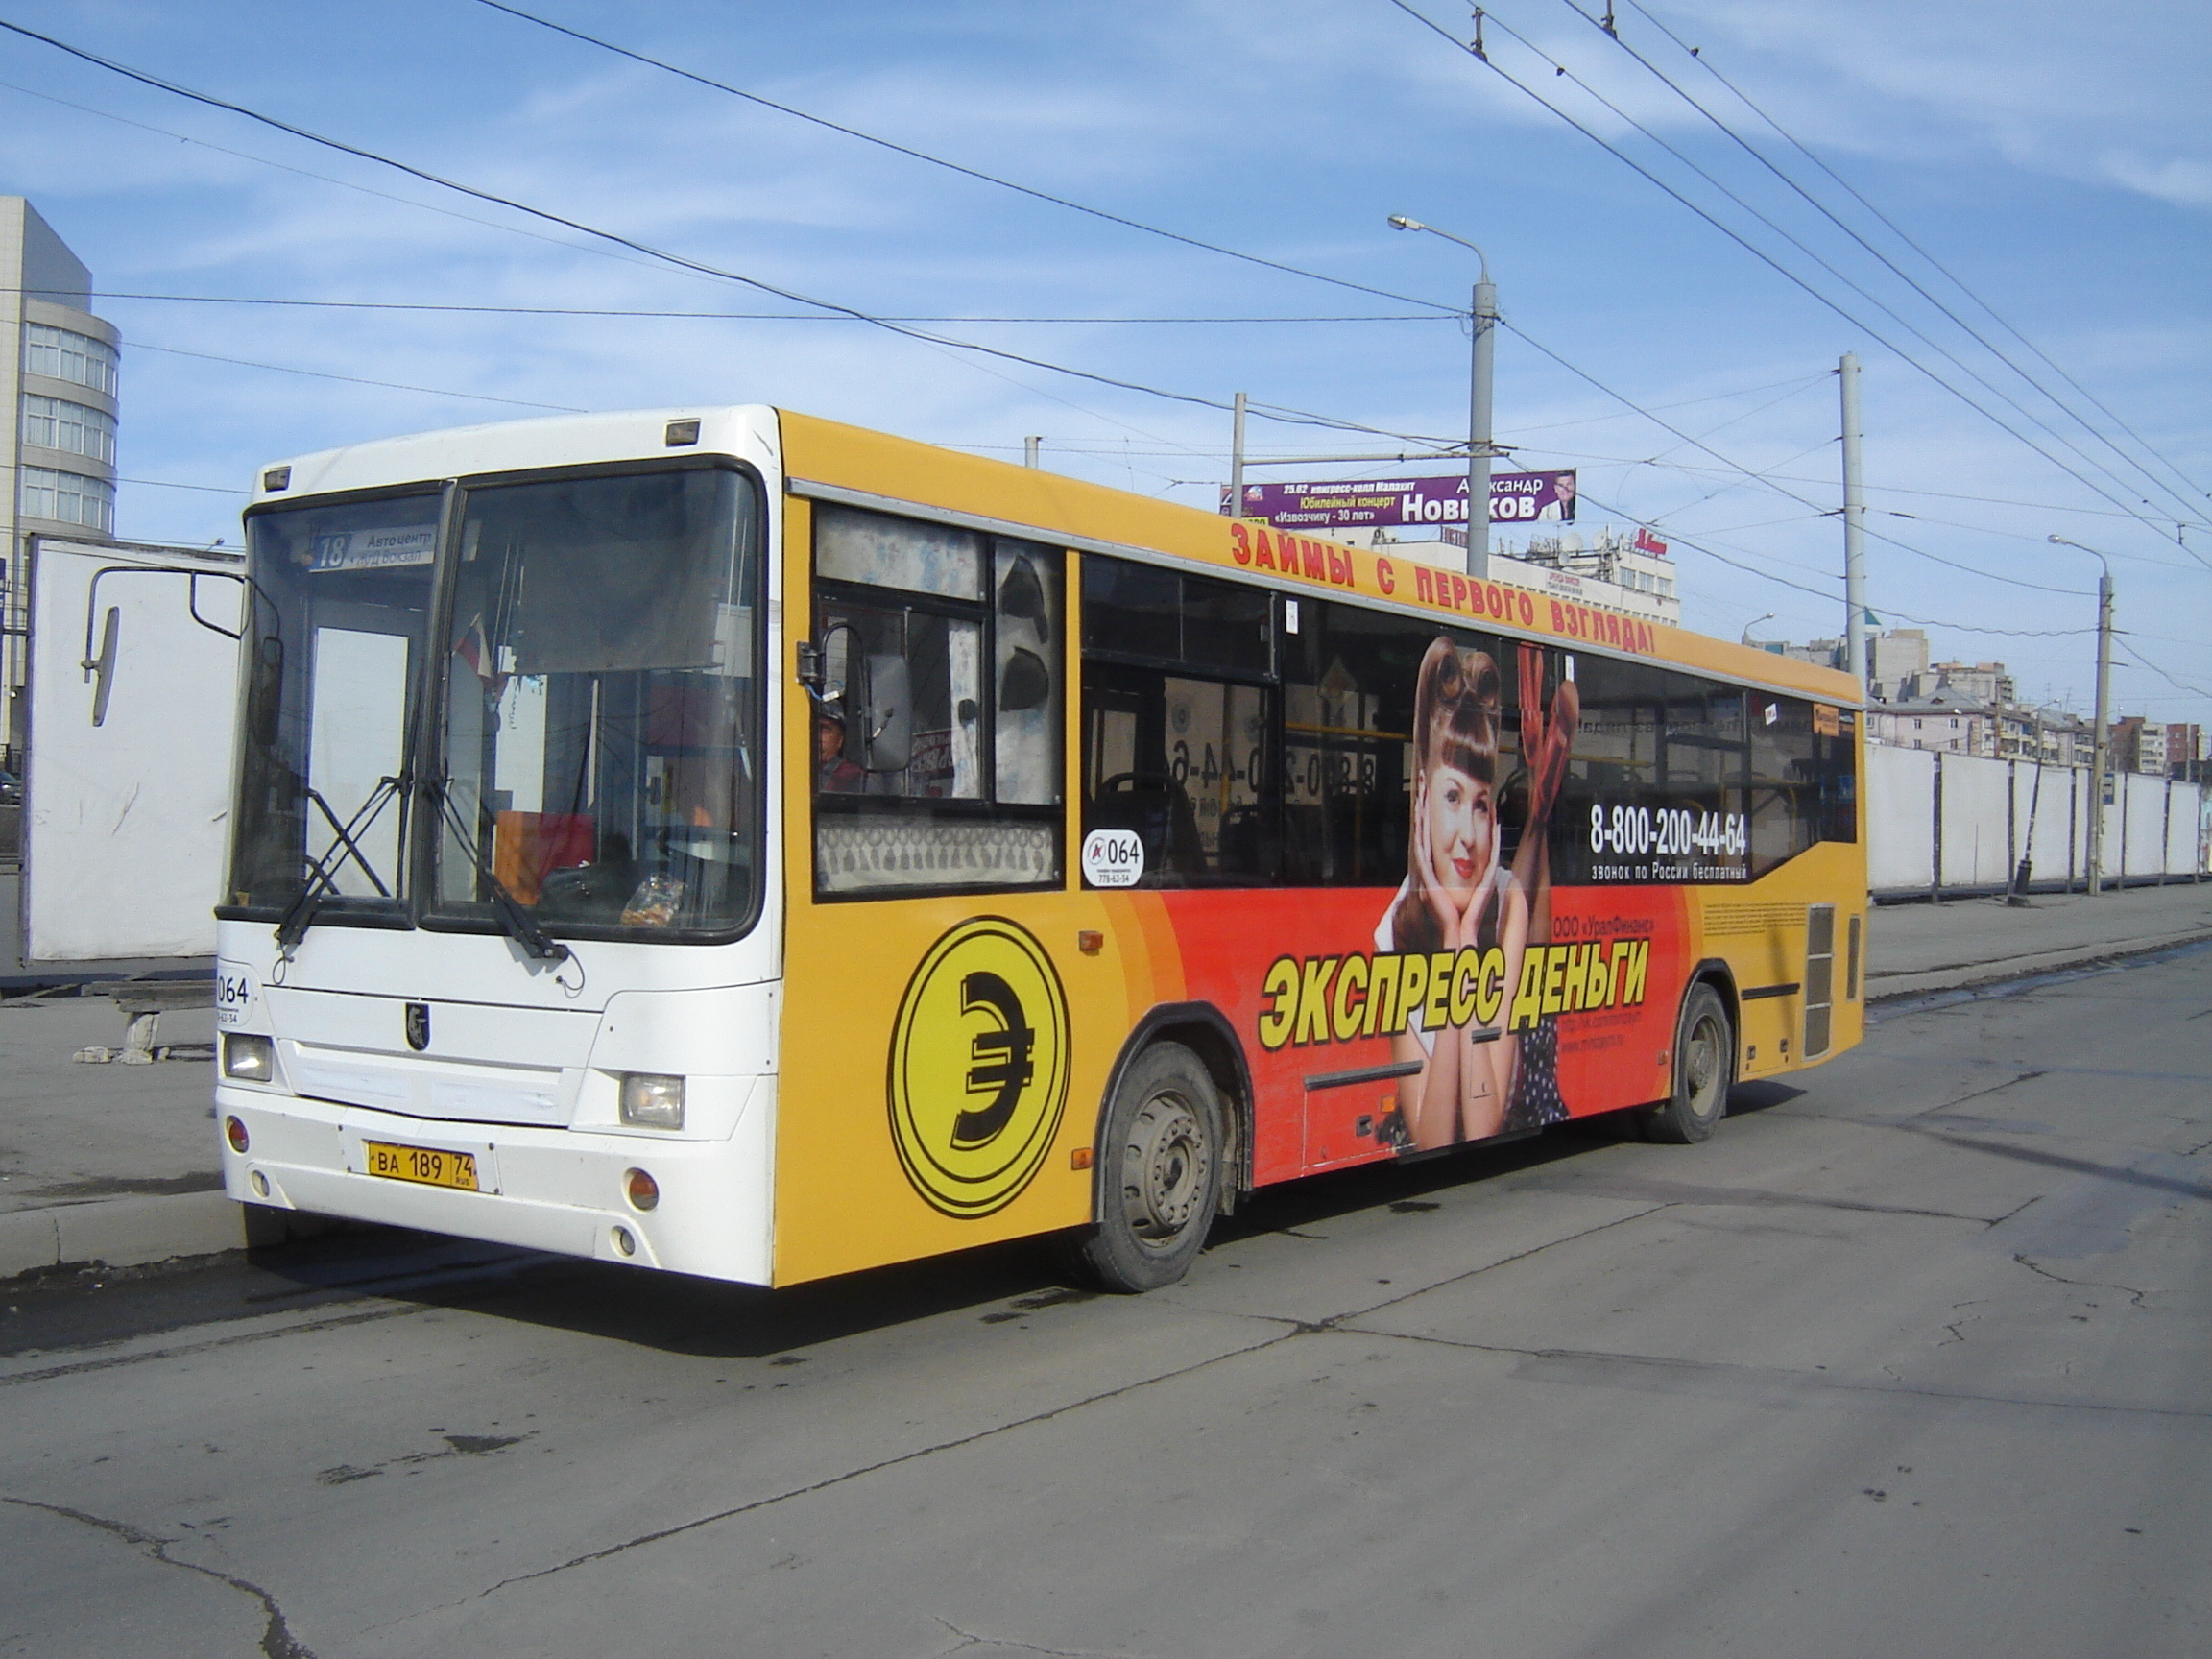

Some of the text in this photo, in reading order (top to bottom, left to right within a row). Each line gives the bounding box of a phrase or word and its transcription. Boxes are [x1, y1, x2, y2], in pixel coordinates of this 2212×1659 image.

[1456, 478, 1543, 494] Аксандр
[1300, 495, 1396, 510] Юбилейный концерт
[1337, 510, 1350, 521] 30
[367, 532, 431, 548] Автоцентр
[320, 536, 345, 568] 18
[1231, 523, 1355, 588] ЗАЙМЫ
[1414, 565, 1534, 626] ПЕРВОГО
[1550, 599, 1655, 654] ВЗГЛЯДА!
[1590, 804, 1746, 855] 8-800-200-44-64
[1108, 839, 1140, 864] 064
[1591, 862, 1747, 880] звонок по России бесплатный
[1553, 916, 1579, 937] ООО
[1259, 937, 1651, 1052] ЭКСПРЕСС ДЕНЬГИ
[409, 1151, 442, 1179] 189
[454, 1155, 472, 1177] 74
[455, 1177, 469, 1186] RUS
